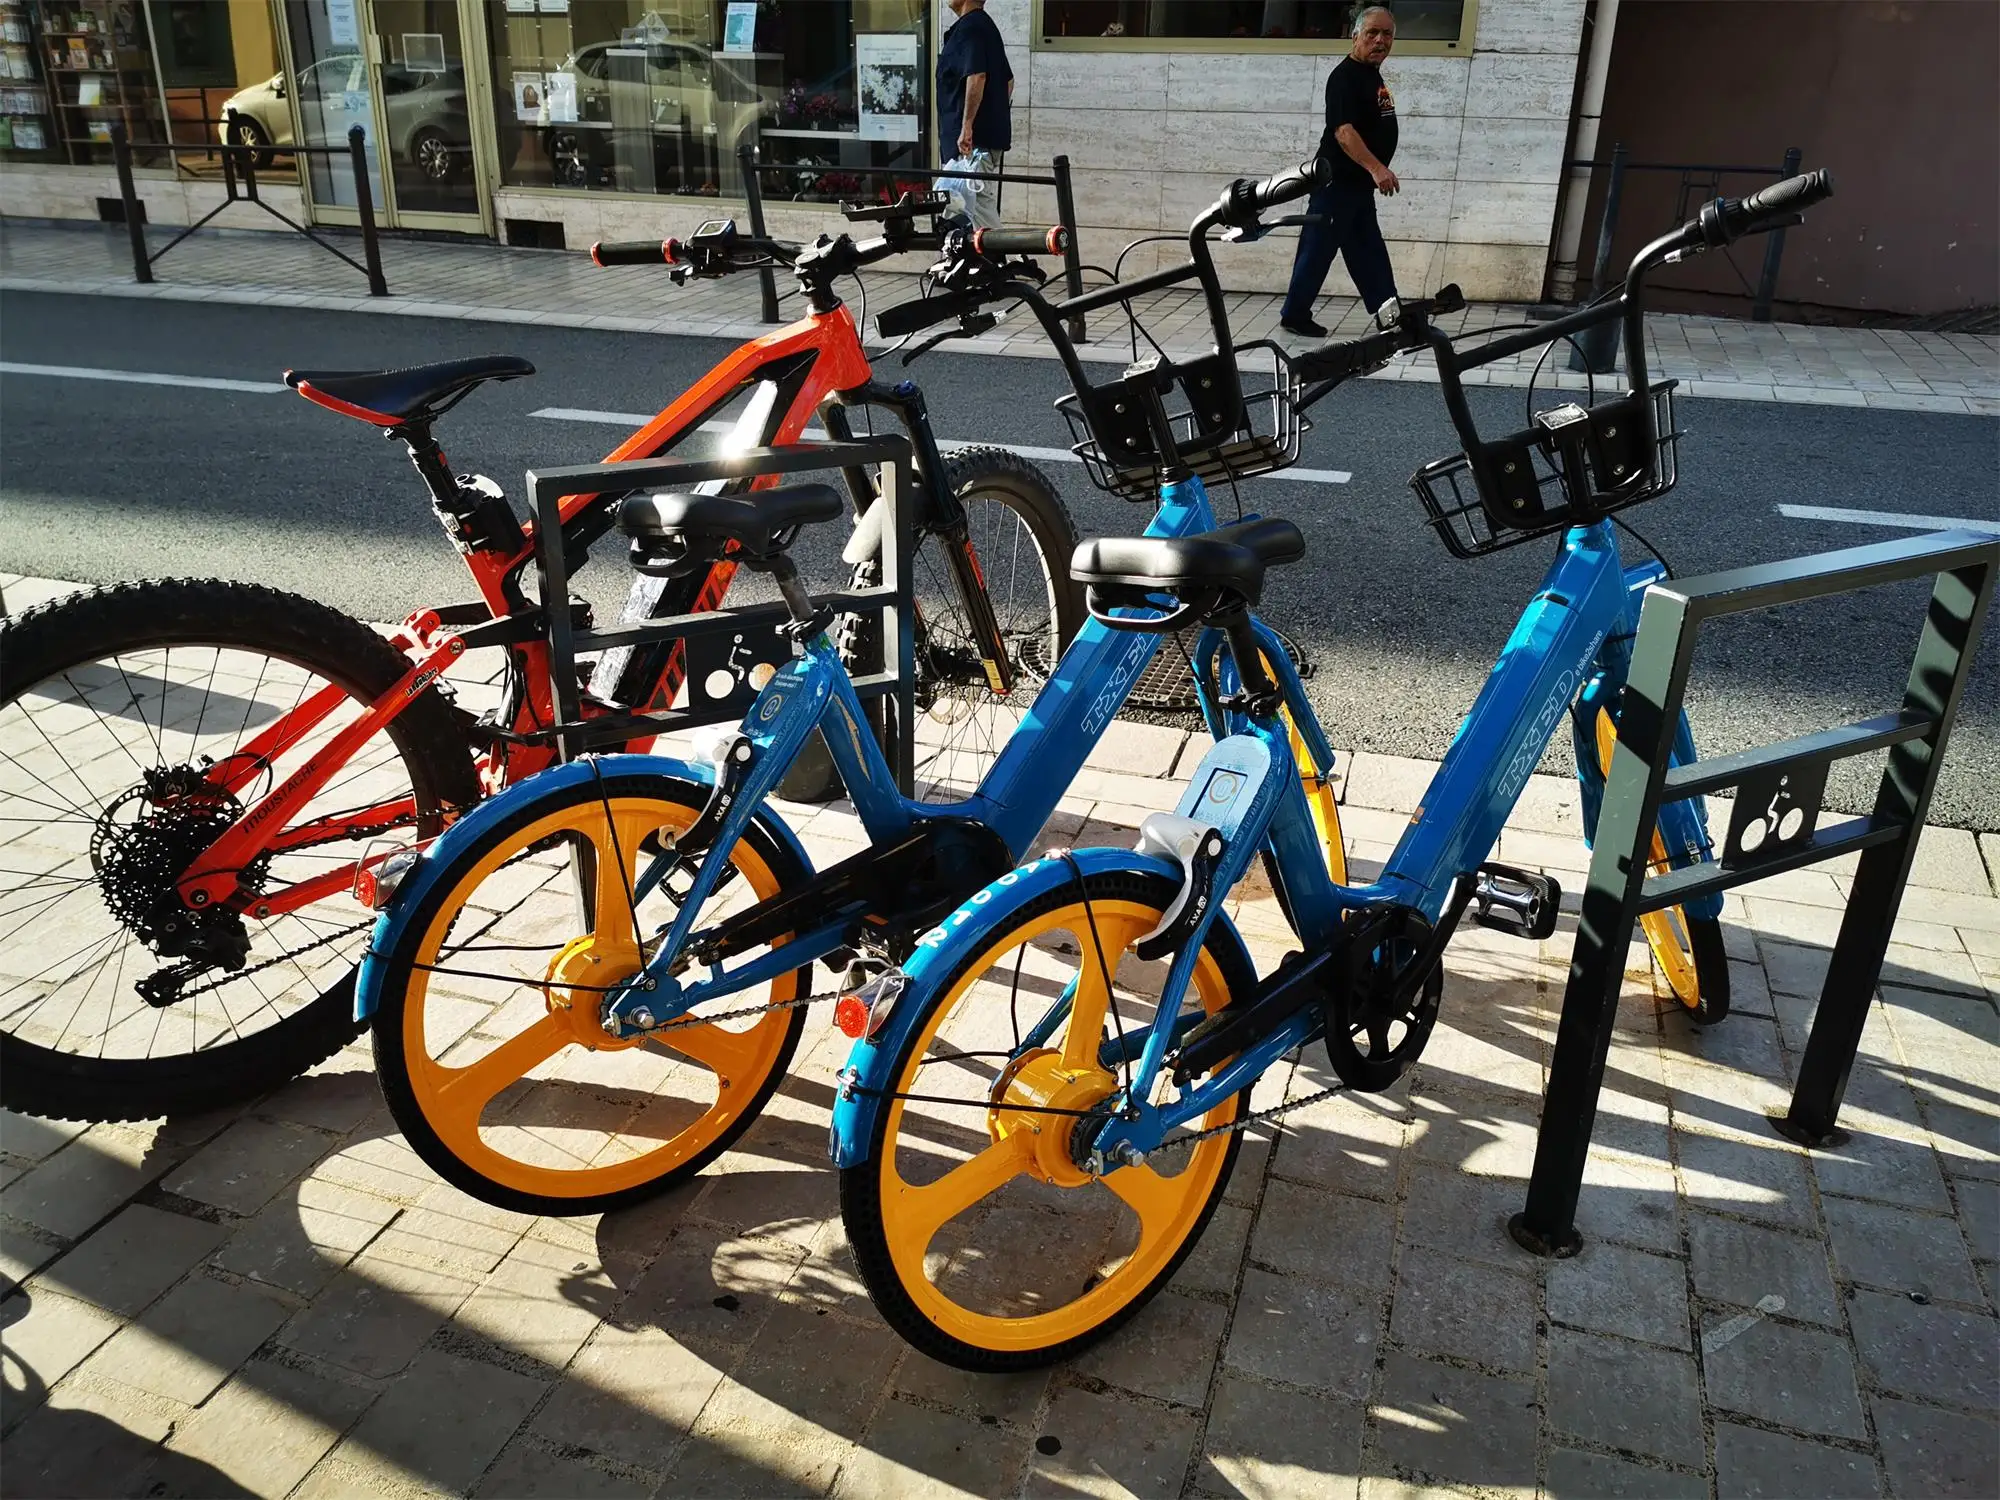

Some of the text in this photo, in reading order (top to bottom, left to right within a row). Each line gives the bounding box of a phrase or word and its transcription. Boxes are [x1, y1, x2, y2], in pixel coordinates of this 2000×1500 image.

[1498, 669, 1575, 797] TXED
[1578, 629, 1603, 671] bike2share
[241, 761, 319, 834] MOUSTACHE
[714, 806, 727, 823] AXA
[1189, 907, 1203, 927] AXA
